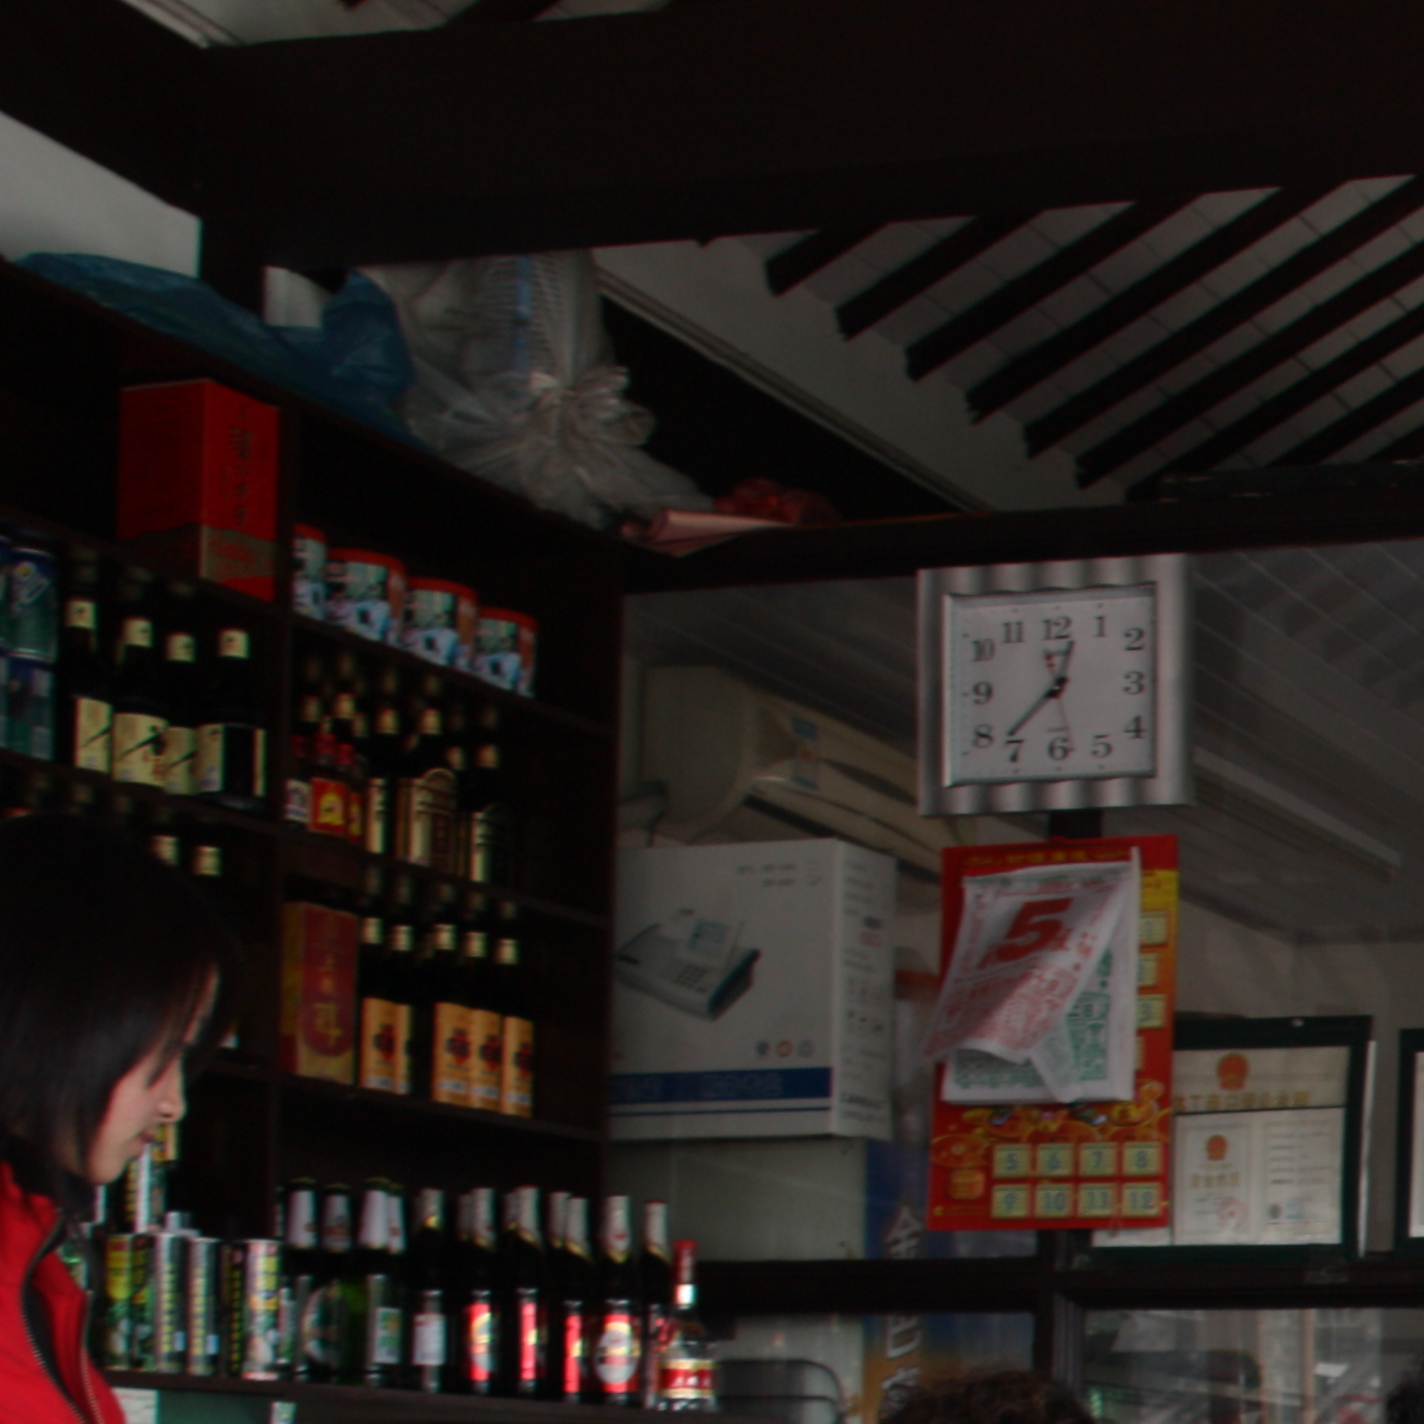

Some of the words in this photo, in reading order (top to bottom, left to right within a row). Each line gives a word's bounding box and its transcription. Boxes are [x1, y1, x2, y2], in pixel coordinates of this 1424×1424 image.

[1003, 621, 1024, 643] 11
[1042, 616, 1071, 639] 12
[1094, 616, 1106, 637] 1
[973, 639, 995, 661] 10
[1125, 628, 1144, 650] 2
[973, 681, 993, 704] 9
[1123, 671, 1143, 694] 3
[973, 724, 993, 748] 8
[1125, 716, 1146, 738] 4
[1005, 739, 1024, 762] 7
[1048, 736, 1070, 760] 6
[1091, 735, 1112, 757] 5
[995, 898, 1073, 961] 5
